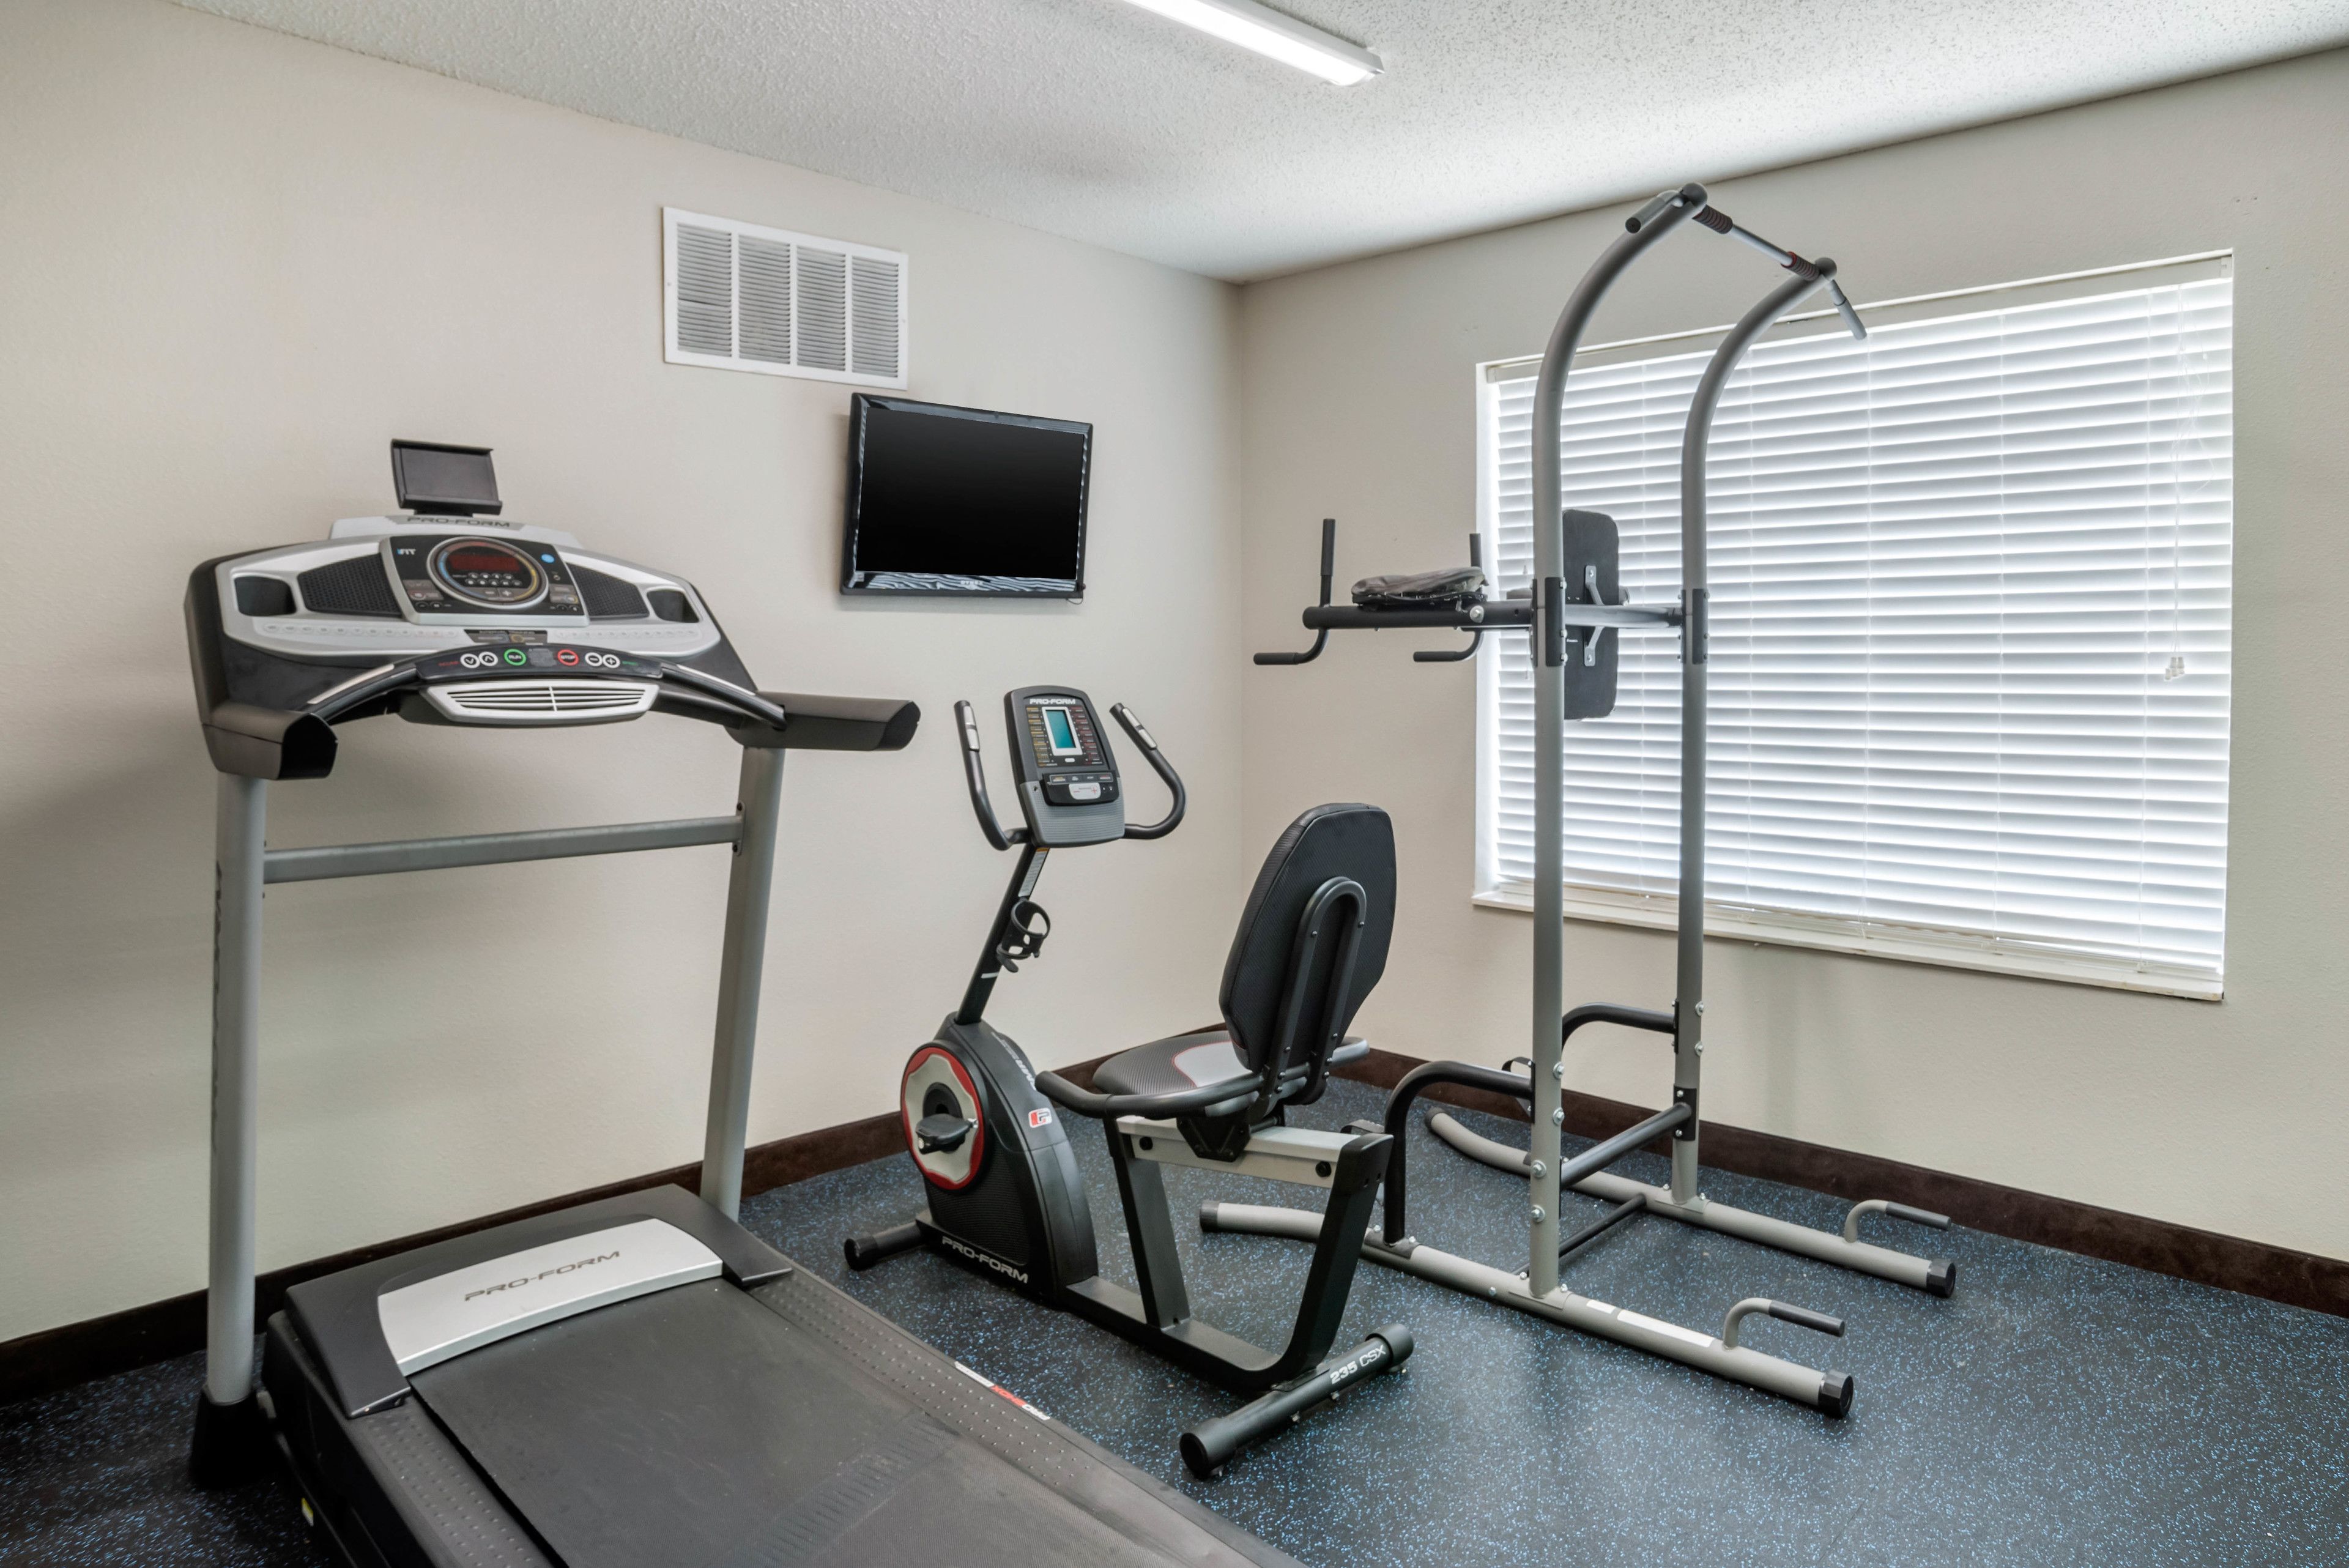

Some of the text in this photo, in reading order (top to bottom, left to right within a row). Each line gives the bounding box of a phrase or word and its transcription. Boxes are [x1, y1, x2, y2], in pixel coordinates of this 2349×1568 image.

[407, 516, 511, 528] PRO-FORM
[464, 1250, 620, 1302] PRO-FORM
[941, 1236, 1029, 1284] PRO-FORM
[1330, 1344, 1387, 1385] 235 CSX
